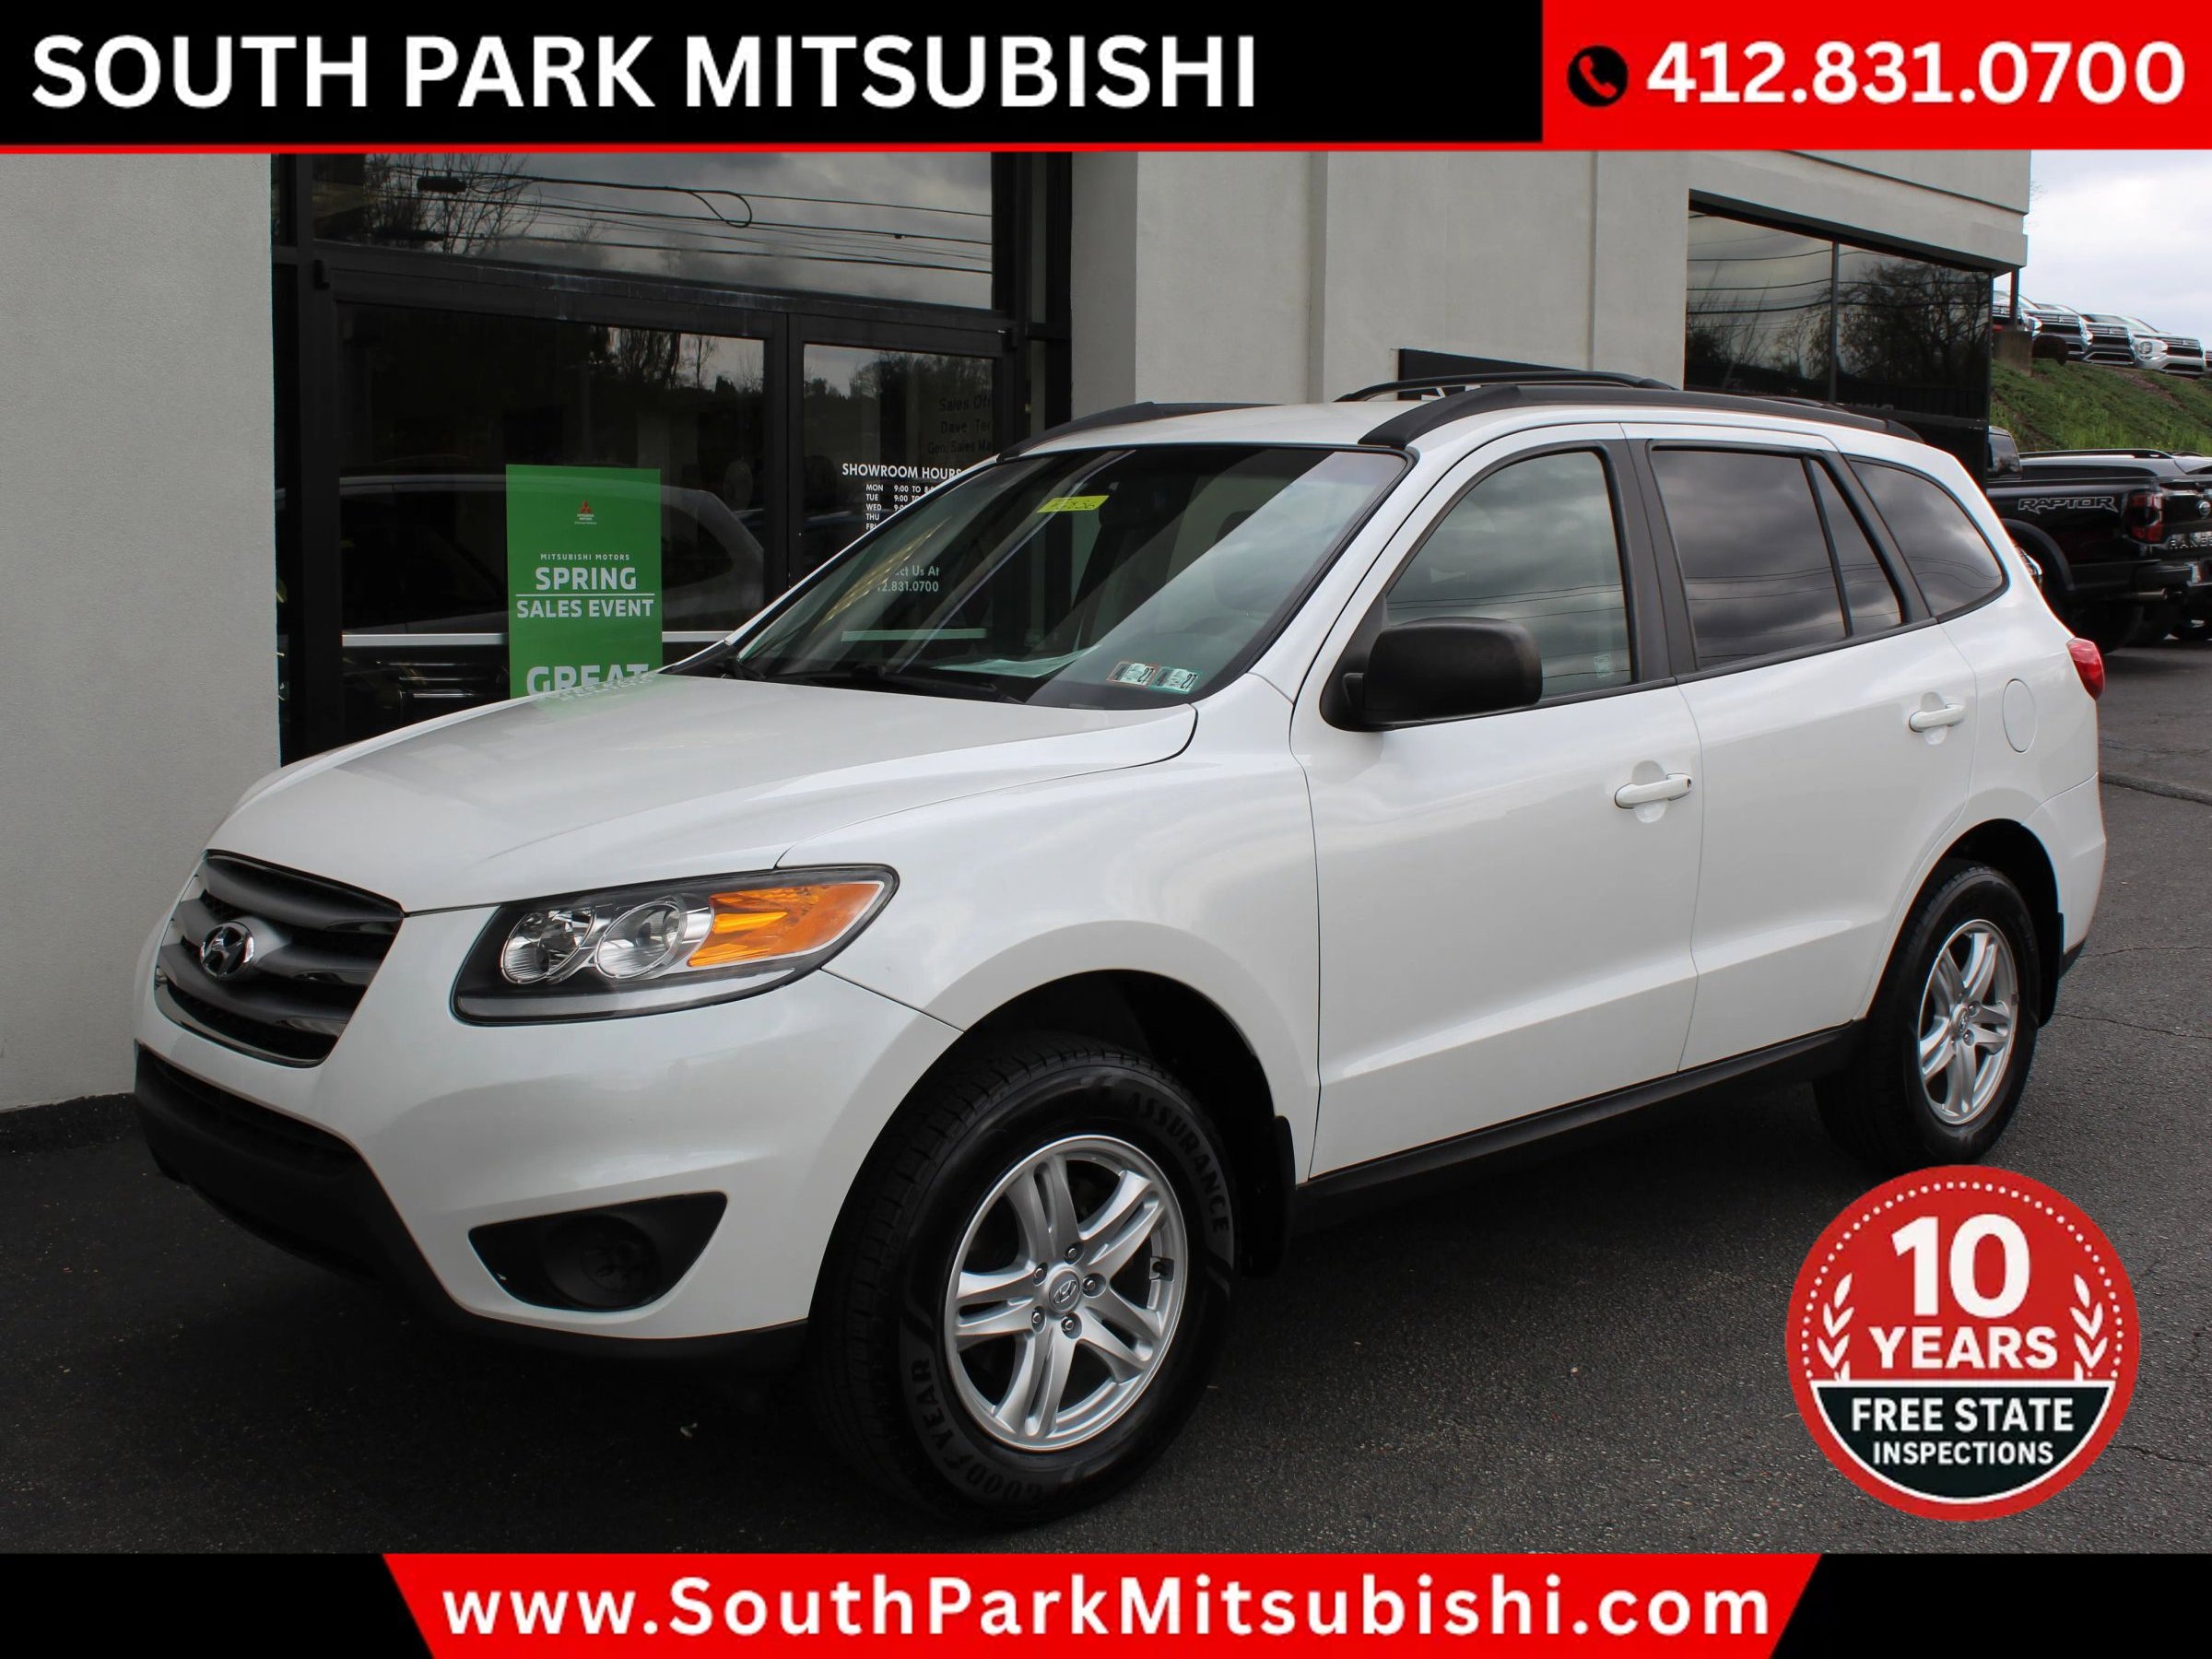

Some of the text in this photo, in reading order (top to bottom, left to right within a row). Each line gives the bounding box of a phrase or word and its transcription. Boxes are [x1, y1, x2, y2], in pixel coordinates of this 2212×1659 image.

[841, 463, 919, 478] SHOWROOM
[893, 485, 909, 493] 9:00
[865, 493, 878, 501] TUE
[893, 494, 909, 502] 9:00
[2018, 496, 2119, 514] RAPTOR
[865, 512, 880, 521] THU
[540, 553, 592, 561] MITSUBISHI
[535, 567, 637, 591] SPRING
[516, 599, 654, 618] SALES EVENT
[1181, 673, 1198, 689] 27
[1127, 1091, 1230, 1233] ASSURANCE
